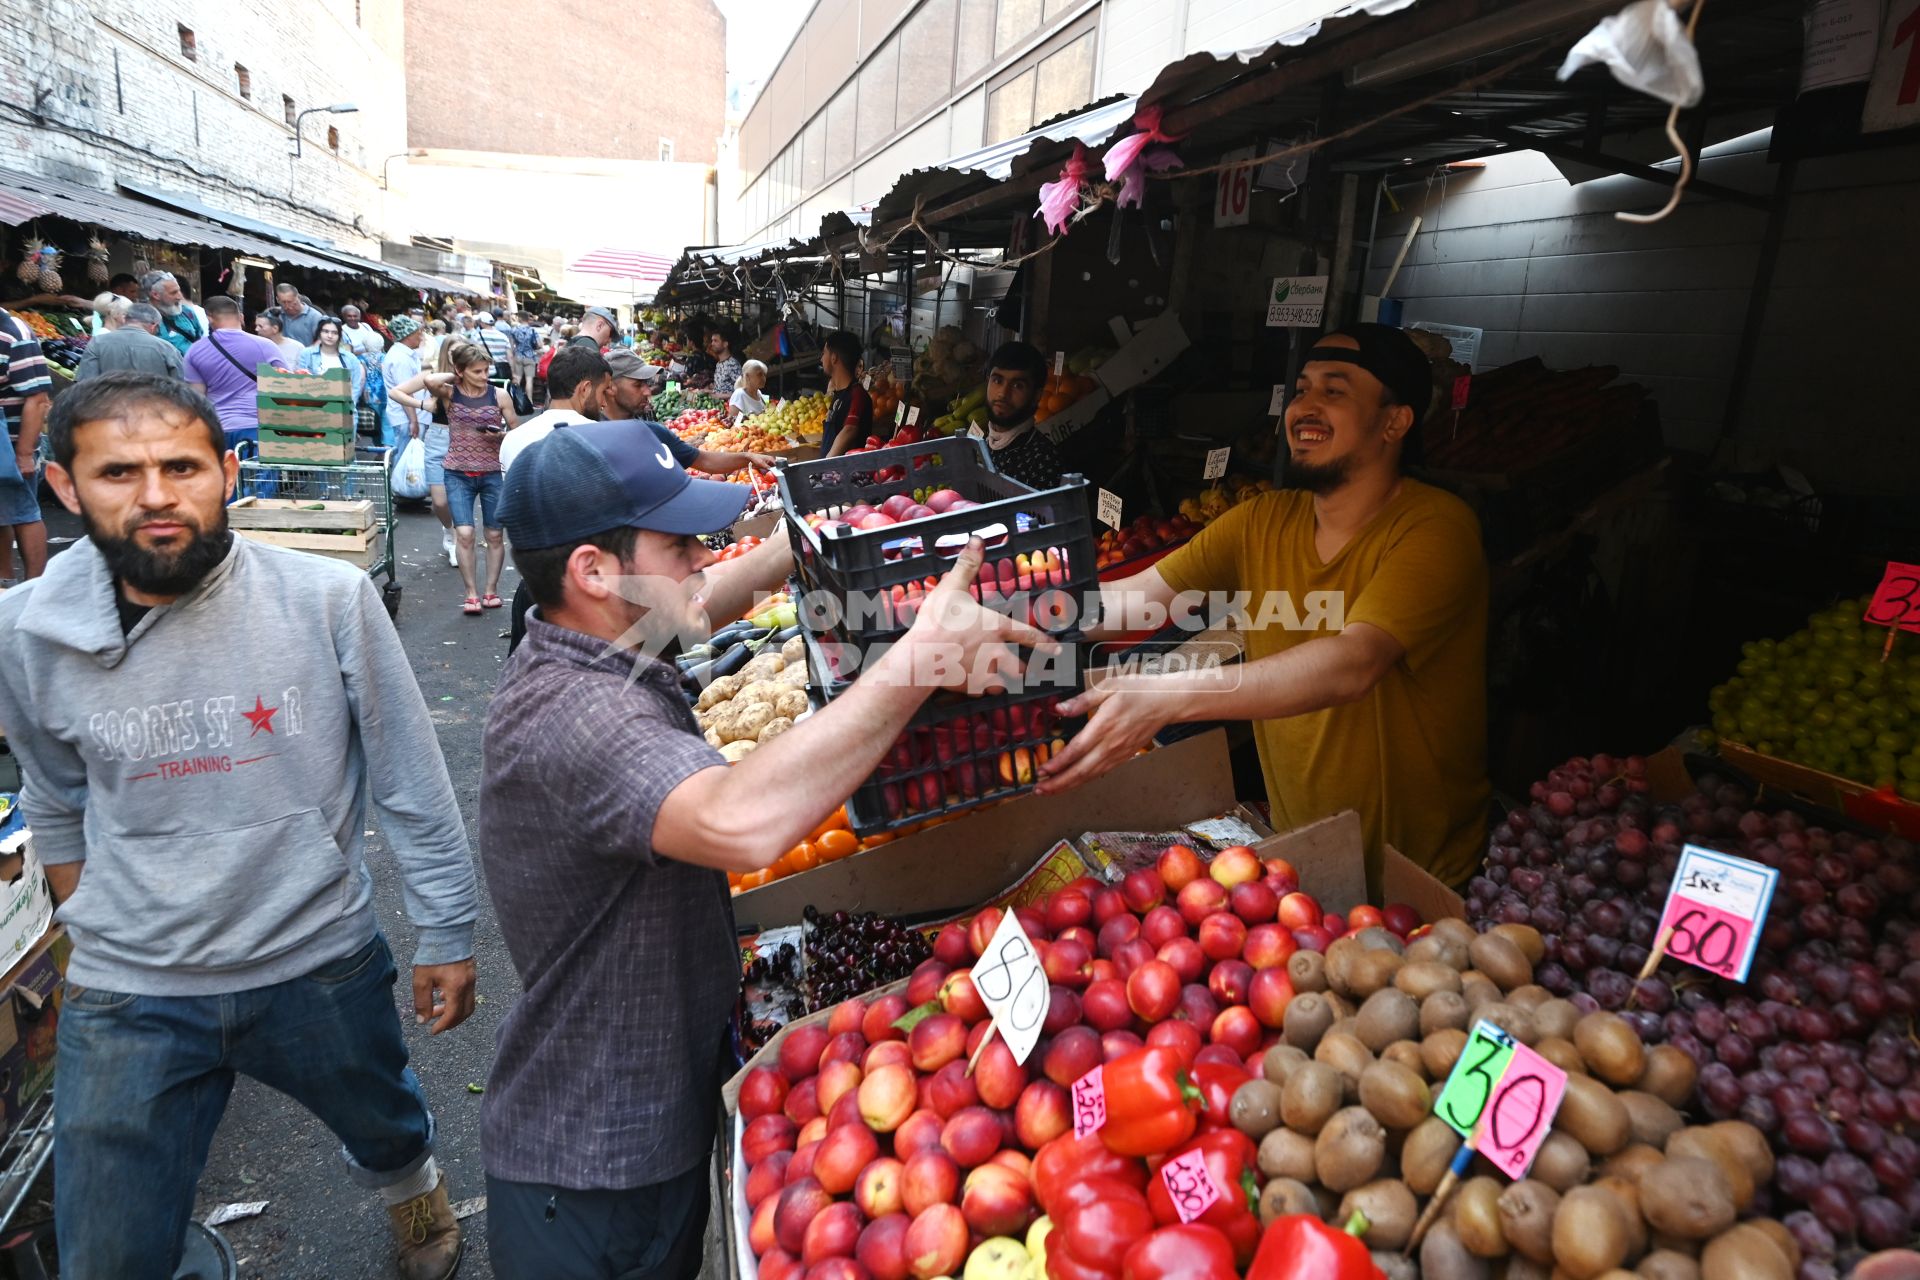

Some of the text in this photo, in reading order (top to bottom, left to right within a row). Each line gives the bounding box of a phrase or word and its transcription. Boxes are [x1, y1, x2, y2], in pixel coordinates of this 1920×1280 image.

[1220, 158, 1248, 216] 16
[1290, 280, 1324, 297] Сбербанк
[90, 700, 200, 761] SPORTS
[158, 757, 232, 780] TRAINING
